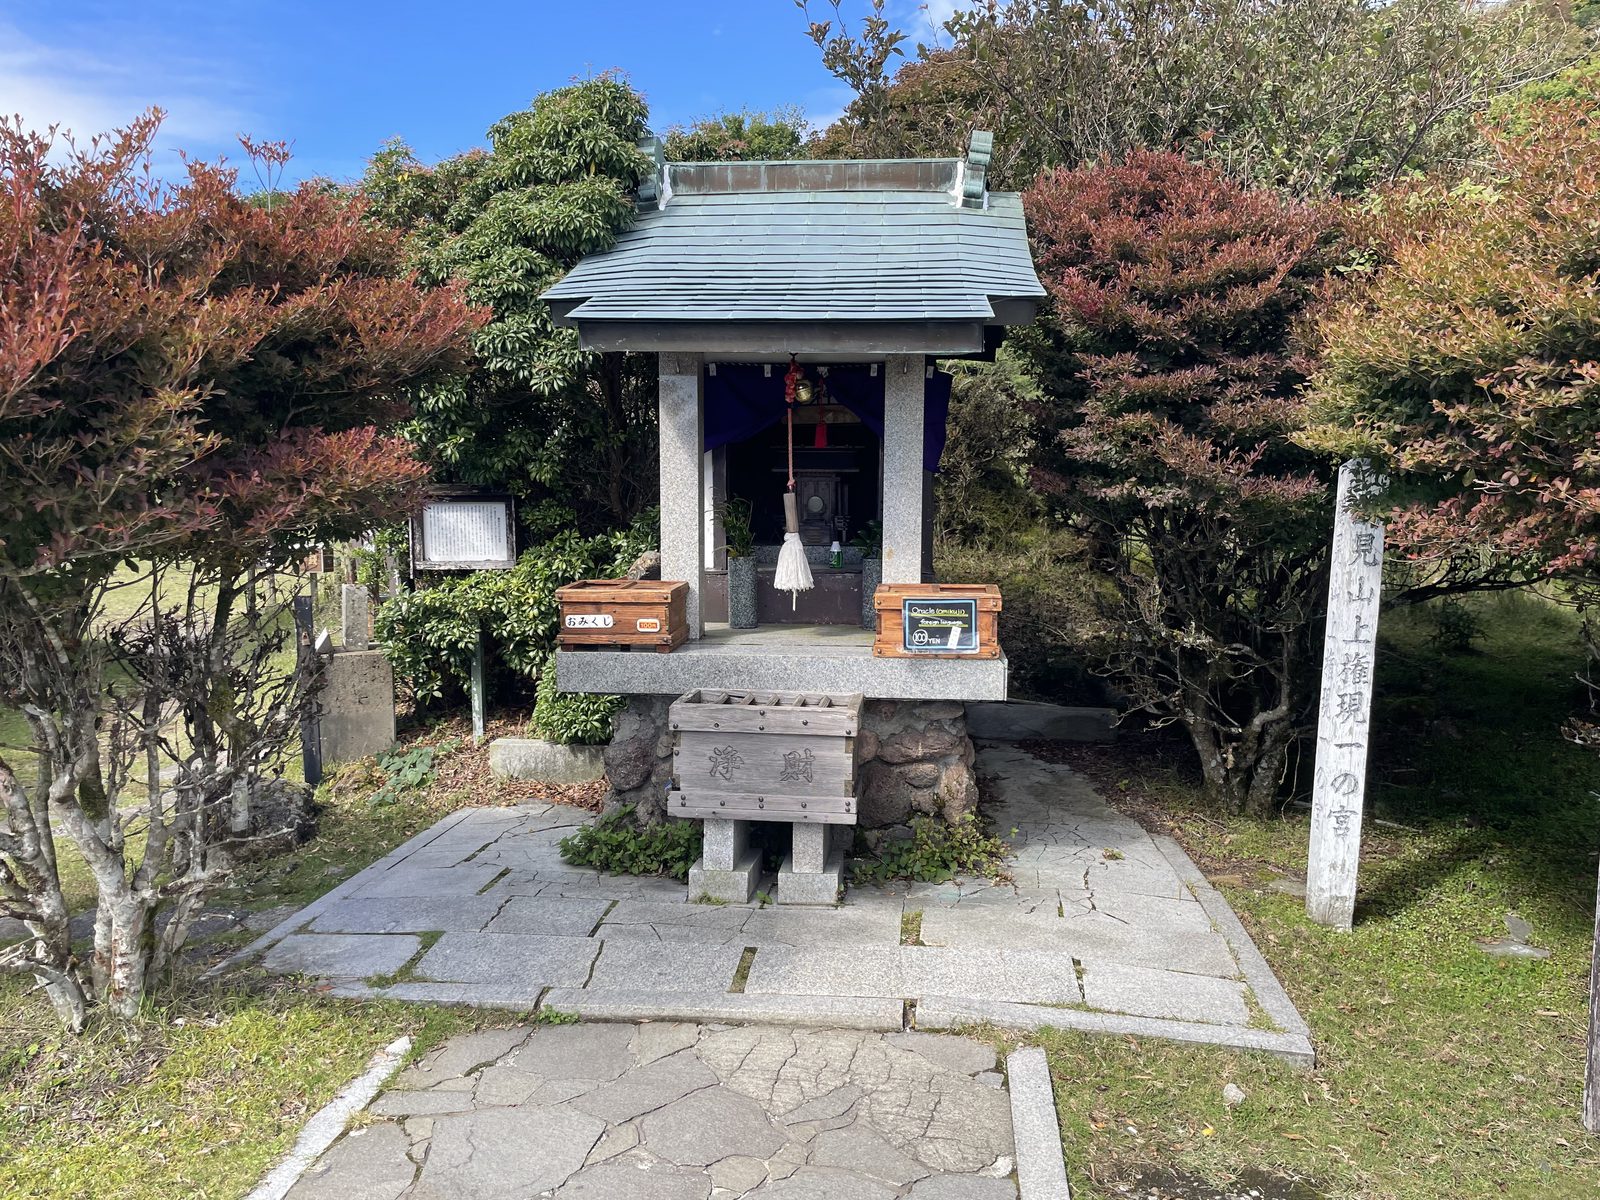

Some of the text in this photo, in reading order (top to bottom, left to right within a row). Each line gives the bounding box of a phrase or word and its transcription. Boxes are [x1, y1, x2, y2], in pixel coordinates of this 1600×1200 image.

[911, 606, 935, 615] Oracle
[567, 616, 611, 627] おみくじ
[1327, 518, 1382, 838] 見山上権現一の宮
